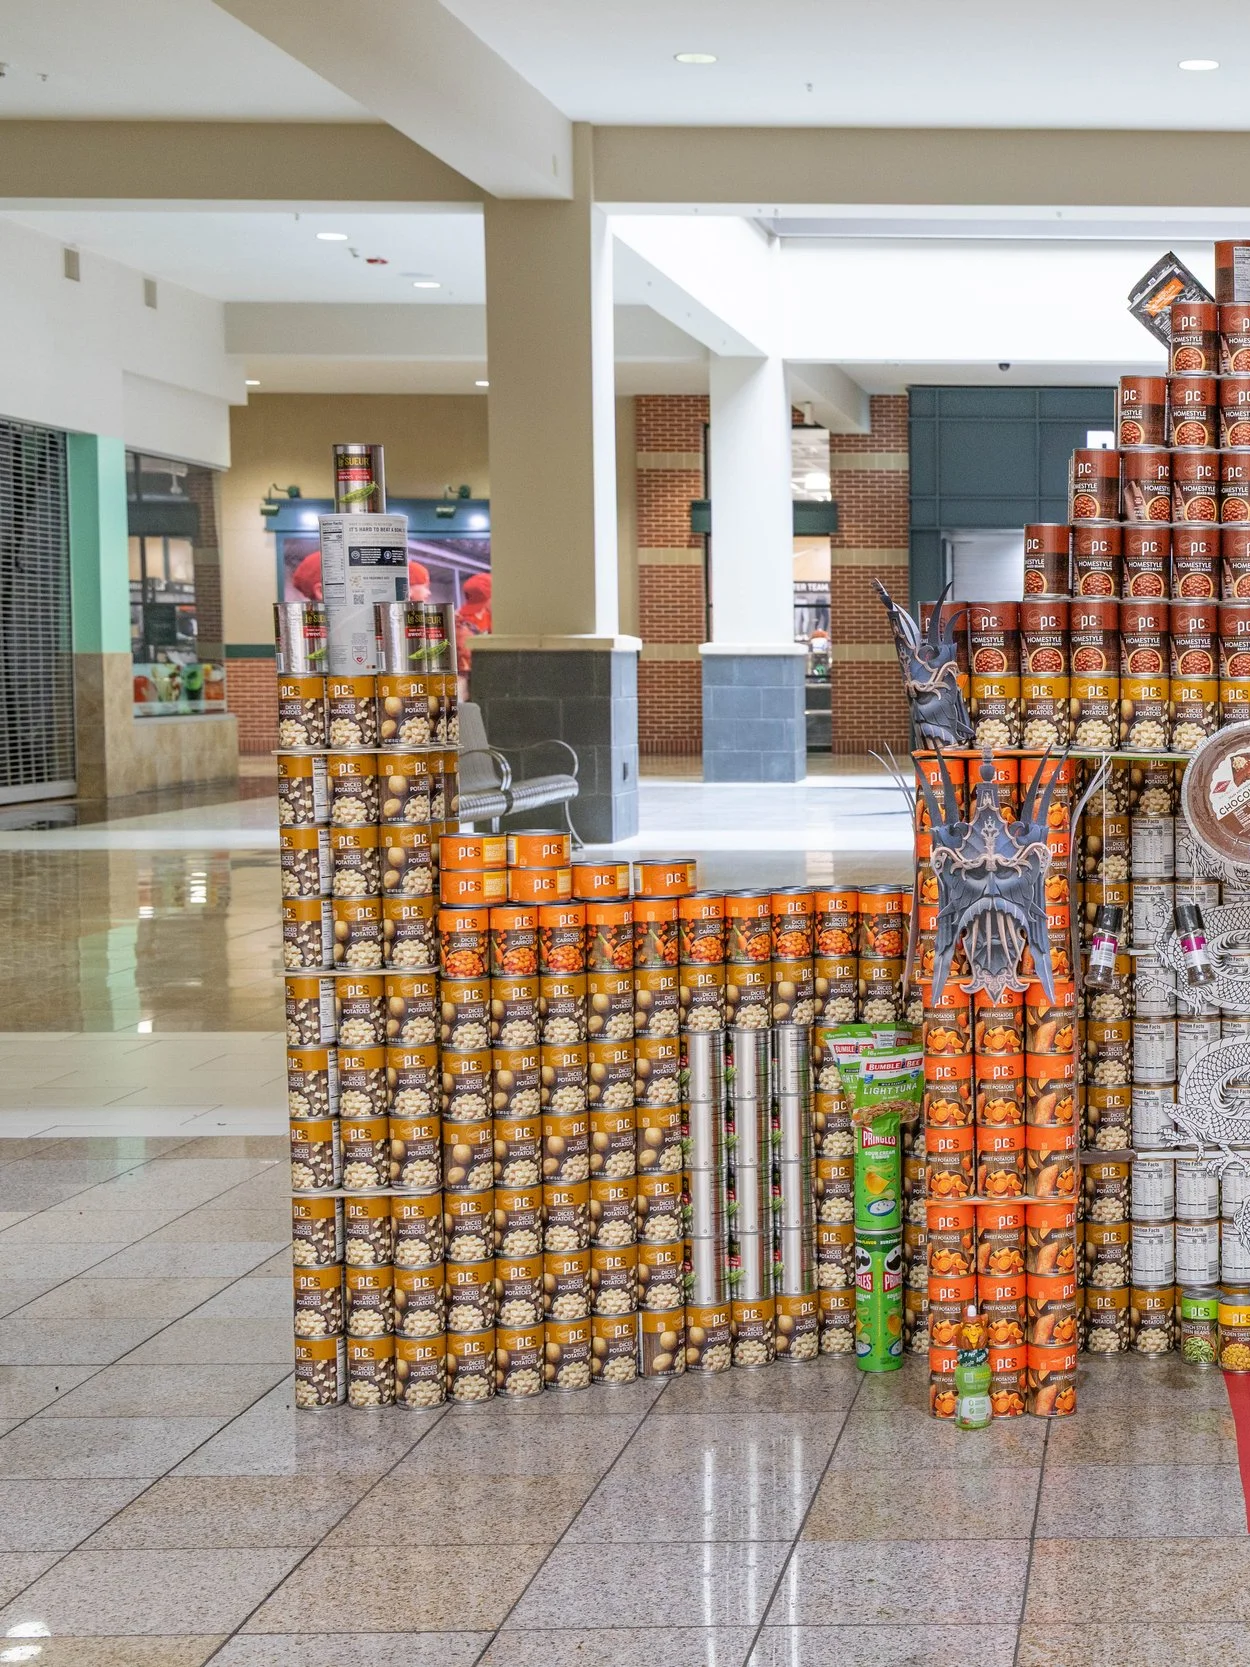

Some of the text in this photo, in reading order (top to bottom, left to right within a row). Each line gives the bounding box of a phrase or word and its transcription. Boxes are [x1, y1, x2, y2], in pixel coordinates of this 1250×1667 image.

[344, 456, 370, 466] SUEUR
[1126, 638, 1160, 646] HOMESTYLE
[835, 1045, 855, 1053] BUMBLE
[868, 1059, 921, 1071] BUMBLE BEE
[863, 1083, 918, 1095] LIGHT TUNA
